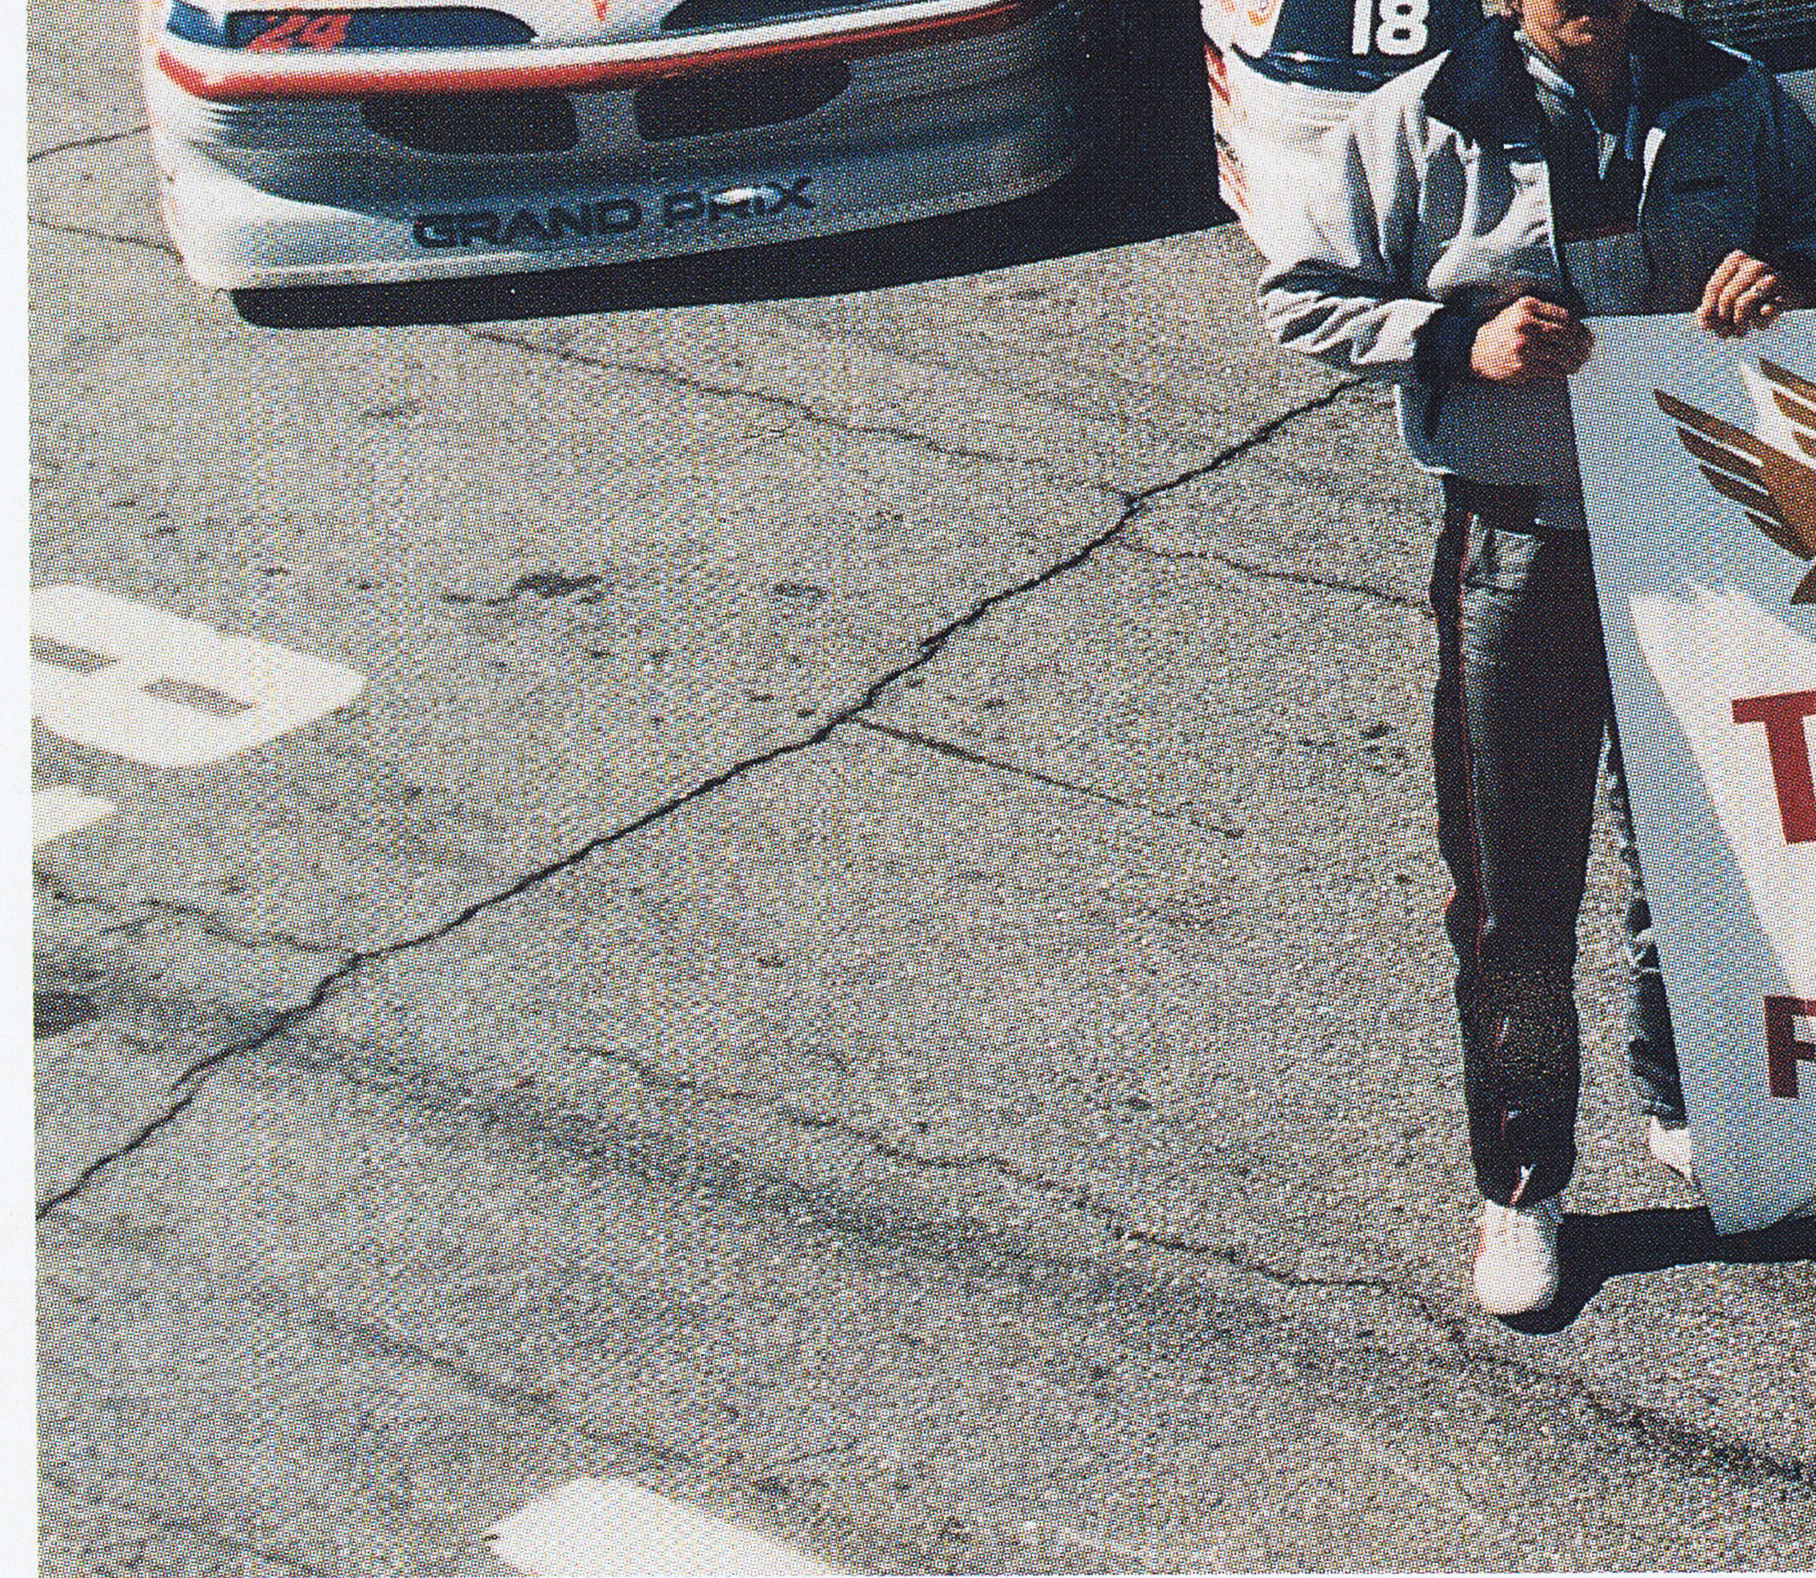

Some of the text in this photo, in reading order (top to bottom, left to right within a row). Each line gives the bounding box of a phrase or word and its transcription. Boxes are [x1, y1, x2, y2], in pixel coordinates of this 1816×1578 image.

[247, 13, 353, 53] 24
[412, 176, 815, 249] GRAND PRIX
